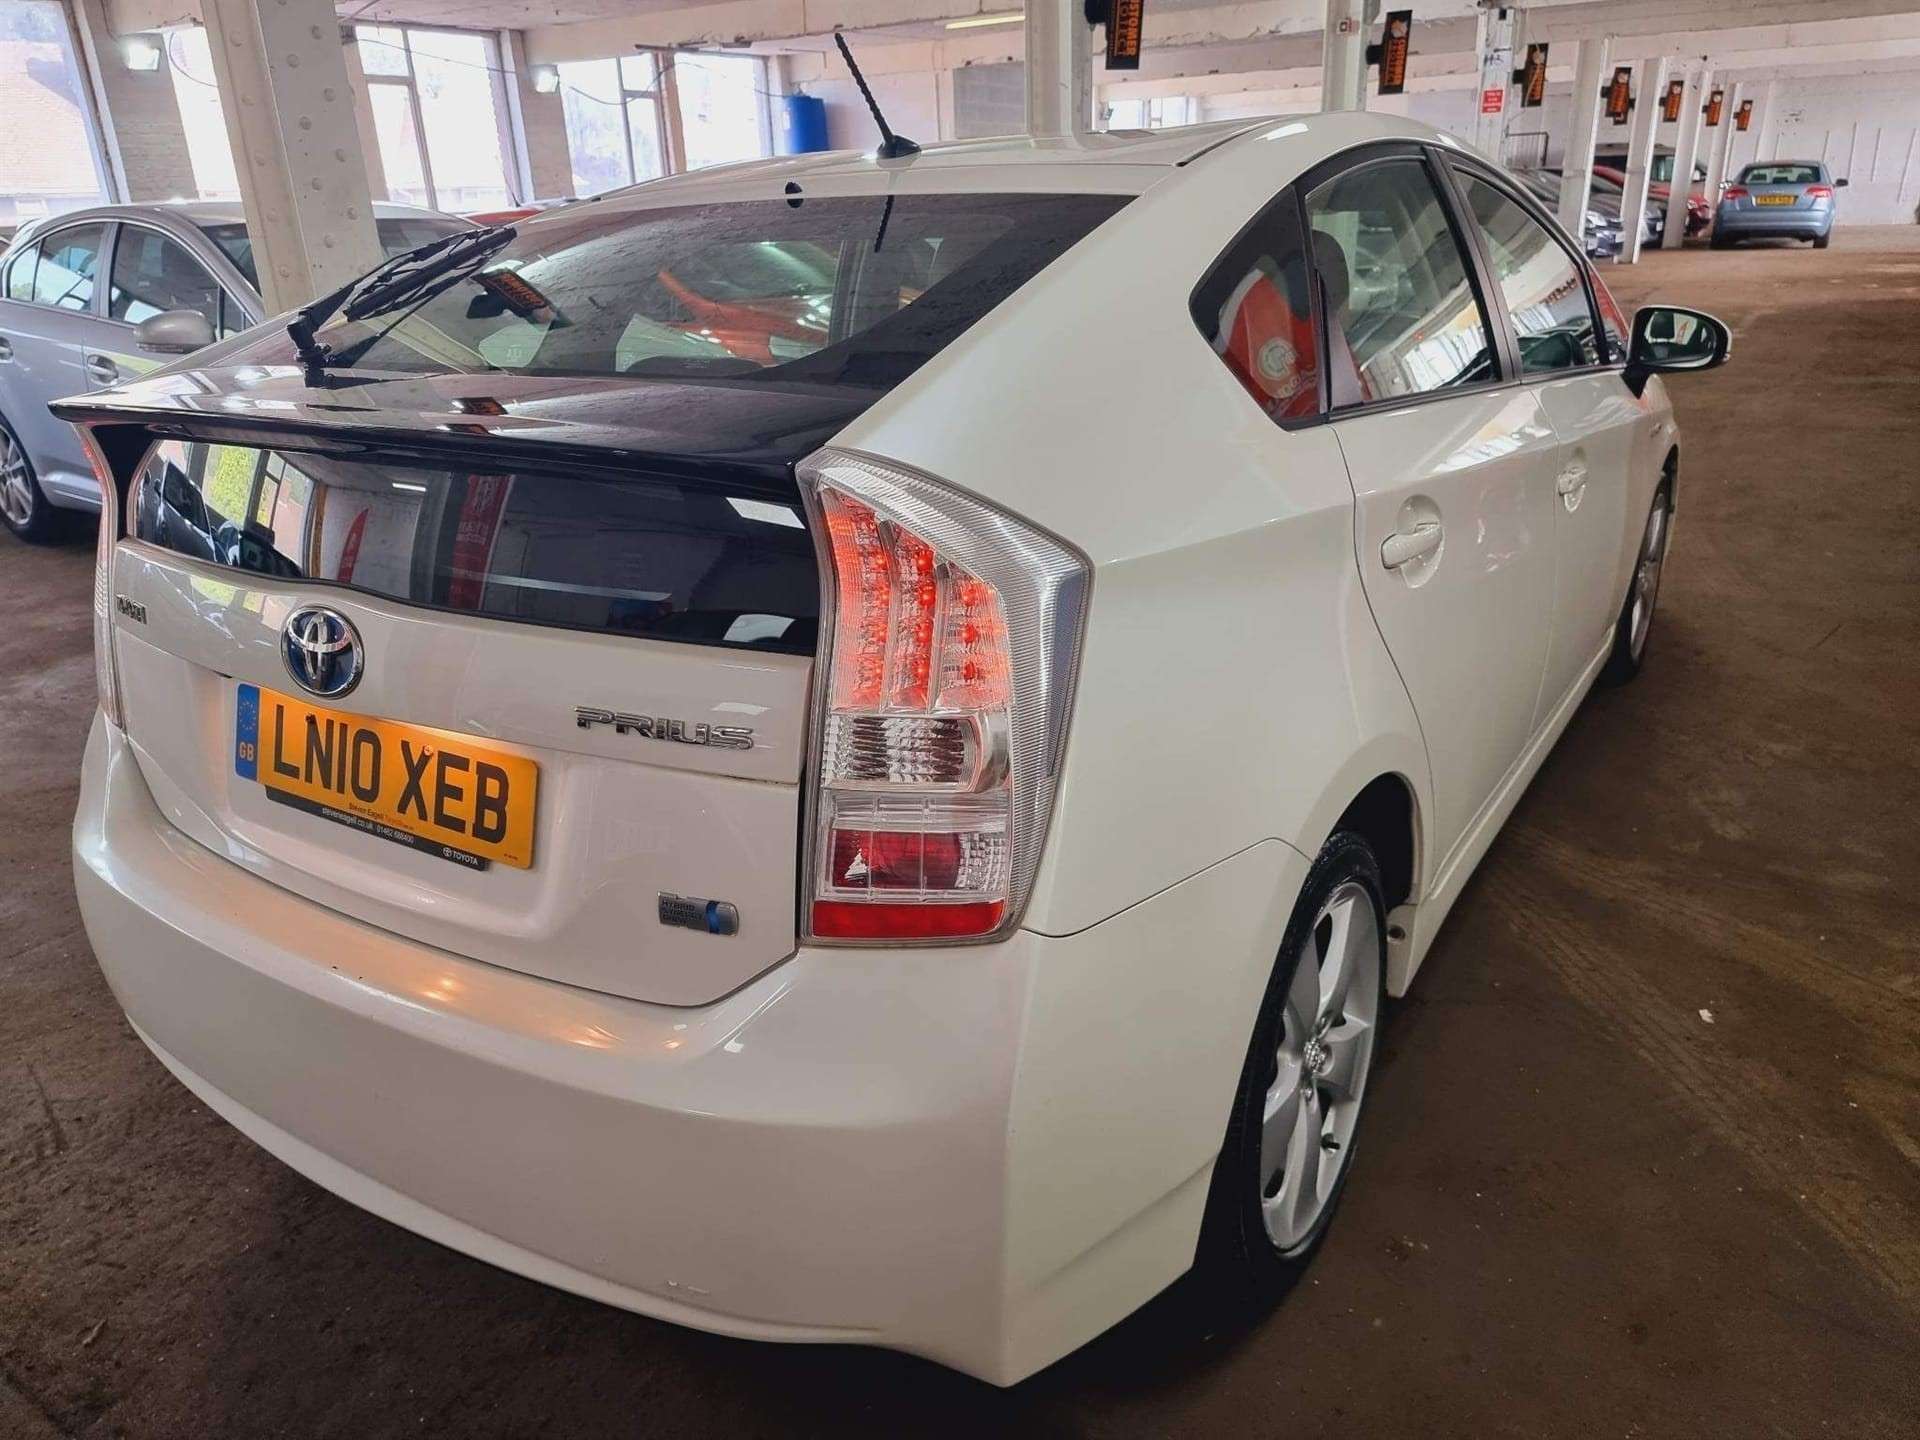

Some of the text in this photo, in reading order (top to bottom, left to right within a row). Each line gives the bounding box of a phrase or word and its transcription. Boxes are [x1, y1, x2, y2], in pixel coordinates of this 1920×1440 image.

[575, 706, 754, 750] PRIUS
[239, 741, 254, 763] GB
[273, 704, 509, 844] LN10 XEB
[453, 850, 479, 866] TOYOTA
